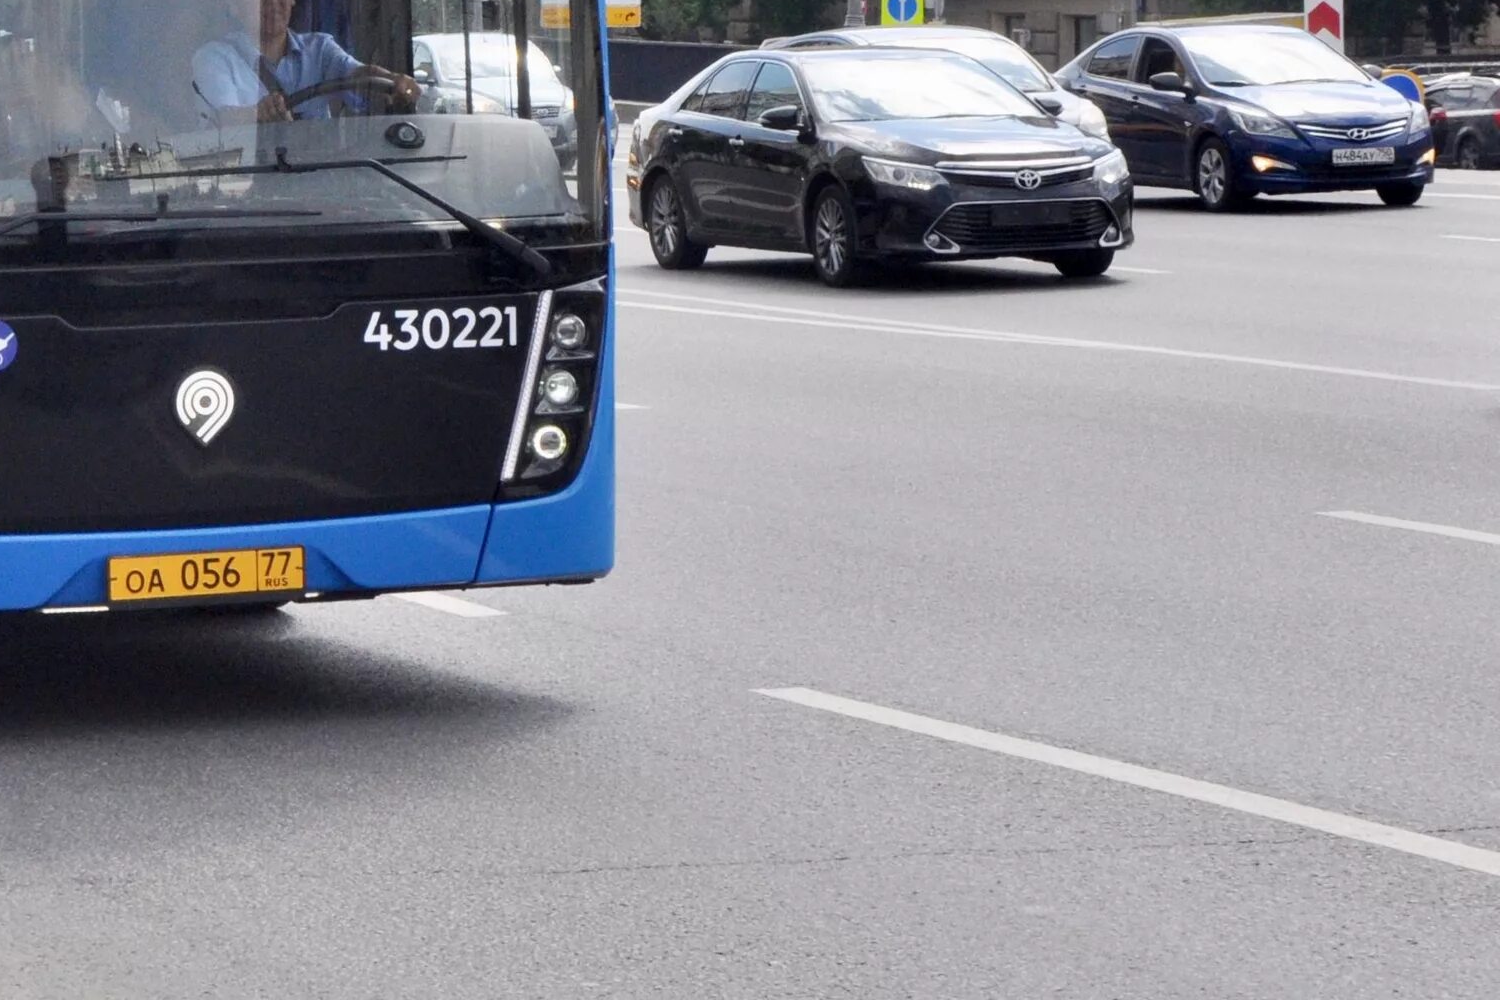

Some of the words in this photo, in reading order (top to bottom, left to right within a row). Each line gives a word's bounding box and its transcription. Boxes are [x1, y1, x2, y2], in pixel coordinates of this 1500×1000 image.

[363, 306, 517, 350] 430221
[125, 569, 165, 594] ОА
[181, 557, 241, 590] 056
[261, 552, 291, 577] 77
[265, 577, 289, 587] RUS
